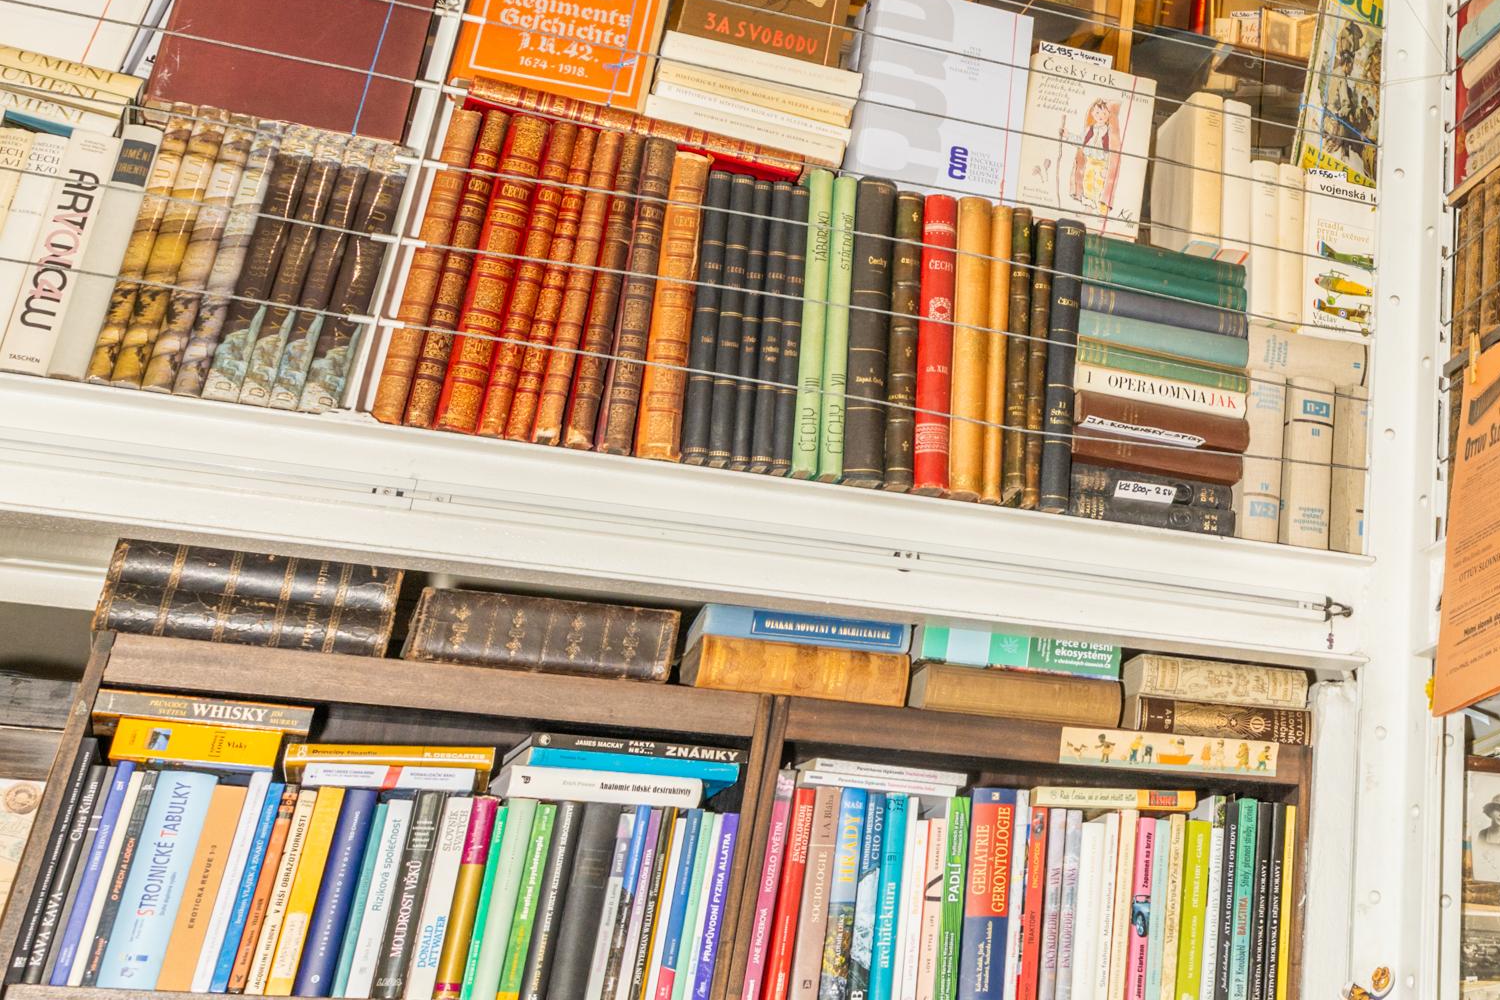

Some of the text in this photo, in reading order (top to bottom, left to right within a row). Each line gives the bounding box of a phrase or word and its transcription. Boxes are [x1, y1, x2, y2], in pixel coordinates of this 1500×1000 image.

[498, 8, 630, 48] Geschichte
[735, 21, 819, 56] SVOBODU
[1042, 56, 1116, 87] Český rok
[27, 151, 61, 165] ČECH
[1320, 182, 1366, 202] vojenská
[1316, 218, 1345, 233] letadla
[1341, 229, 1370, 246] světové
[8, 352, 41, 364] TASCHEN
[1108, 374, 1157, 396] OPERA
[1158, 382, 1207, 405] OMNIA
[1208, 392, 1237, 411] JAK
[1055, 647, 1113, 663] ekosystémy
[191, 702, 268, 722] WHISKY
[575, 739, 624, 750] JAMES MACKAY
[628, 740, 655, 748] FAKTA
[666, 744, 739, 762] ZNÁMKY
[599, 780, 692, 797] Anatomie lidské destruktivity
[70, 780, 99, 842] Chris Kilham
[442, 809, 459, 852] SLOVNÍK
[453, 808, 469, 852] SVATÝCH
[791, 803, 807, 863] ENCYKLOPEDIE
[871, 806, 884, 860] CHO OYU
[135, 780, 193, 917] STROJNICKÉ TABULKY
[280, 814, 307, 894] OBRAZOTVORNOSTI
[799, 804, 814, 864] STAROŽITNOSTÍ
[837, 813, 861, 884] HRADY
[371, 817, 403, 912] Riziková společnost
[712, 833, 732, 905] FYZIKA ALLATRA
[764, 820, 784, 893] KOUZLO KVĚTIN
[971, 824, 990, 896] GERIATRIE
[991, 807, 1012, 913] GERONTOLOGIE
[187, 854, 214, 930] EROTICKÁ REVUE
[811, 850, 828, 924] SOCIOLOGIE
[947, 863, 961, 903] PADLÍ
[29, 890, 64, 967] KAVA KAVA
[390, 859, 423, 959] MOUDROST VĚKŮ
[877, 881, 896, 968] architektura
[416, 924, 434, 969] DONALD
[427, 915, 447, 969] ATTWATER
[1137, 944, 1146, 972] Clarkson
